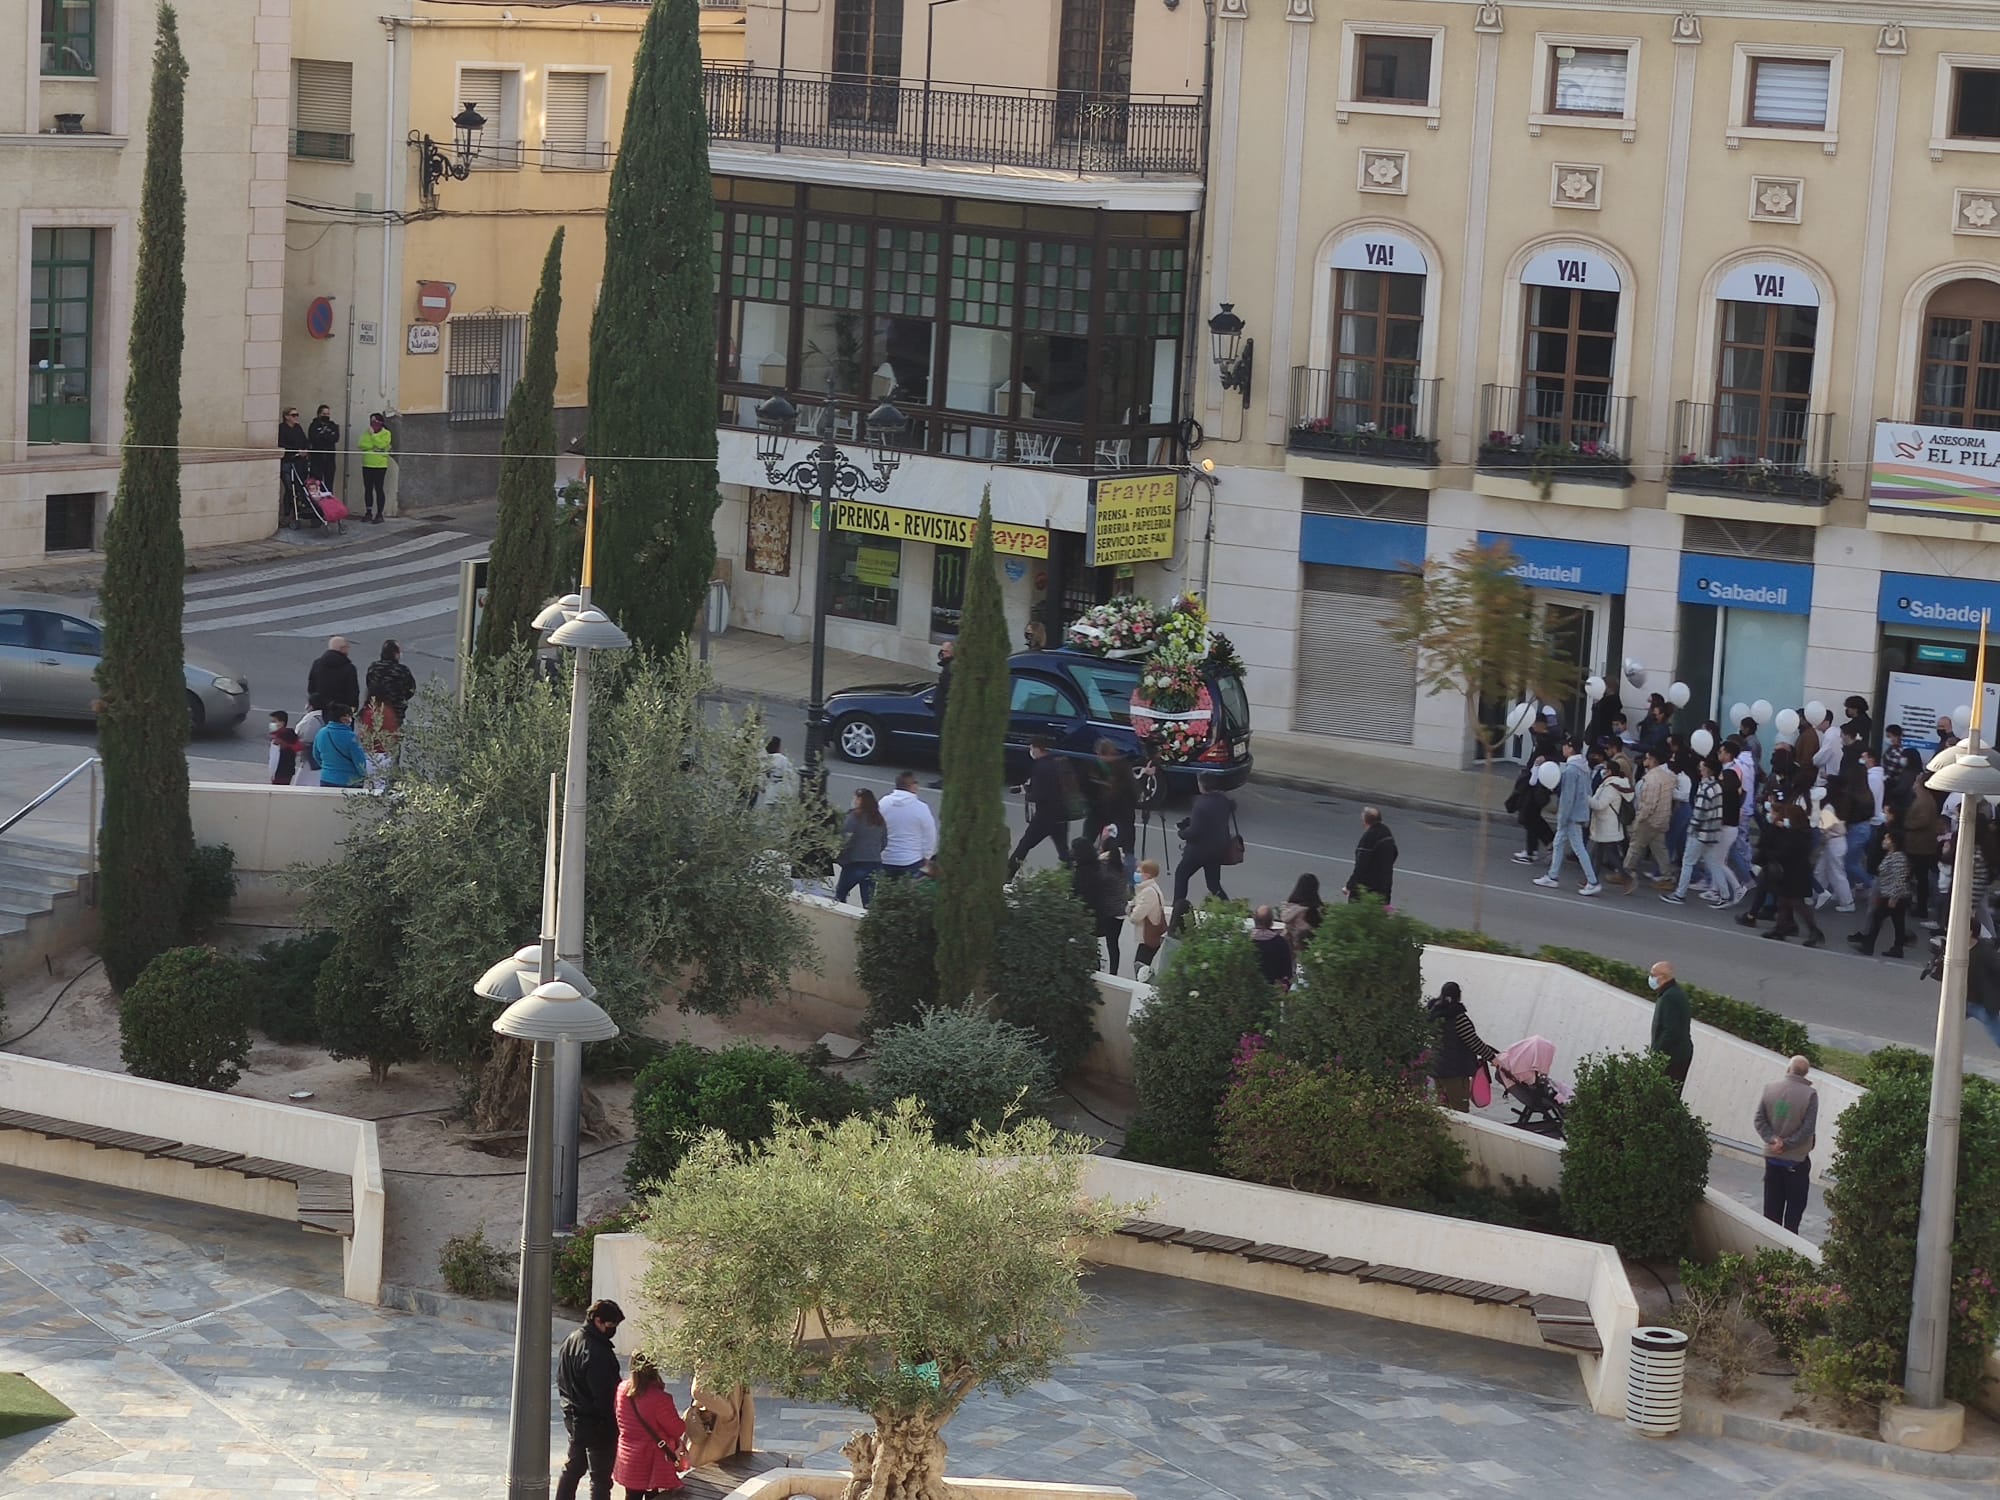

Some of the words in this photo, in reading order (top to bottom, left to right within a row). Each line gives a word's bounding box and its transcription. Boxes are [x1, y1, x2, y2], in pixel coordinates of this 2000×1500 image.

[1365, 243, 1394, 266] YA!
[1557, 259, 1587, 283] YA!
[1754, 273, 1785, 298] YA!
[1929, 434, 1986, 448] ASESORIA
[1927, 447, 1953, 465] EL
[1099, 481, 1174, 503] Fraypa
[838, 504, 890, 532] PRENSA
[904, 513, 967, 543] REVISTAS
[1098, 508, 1127, 522] PRENSA
[1135, 504, 1172, 518] REVISTAS
[1097, 522, 1130, 536] LIBRERIA
[1131, 518, 1171, 532] PAPELERIA
[1096, 535, 1135, 550] SERVICIO
[1137, 534, 1149, 545] DE
[1151, 532, 1167, 544] FAX
[1708, 581, 1788, 605] Sabadell
